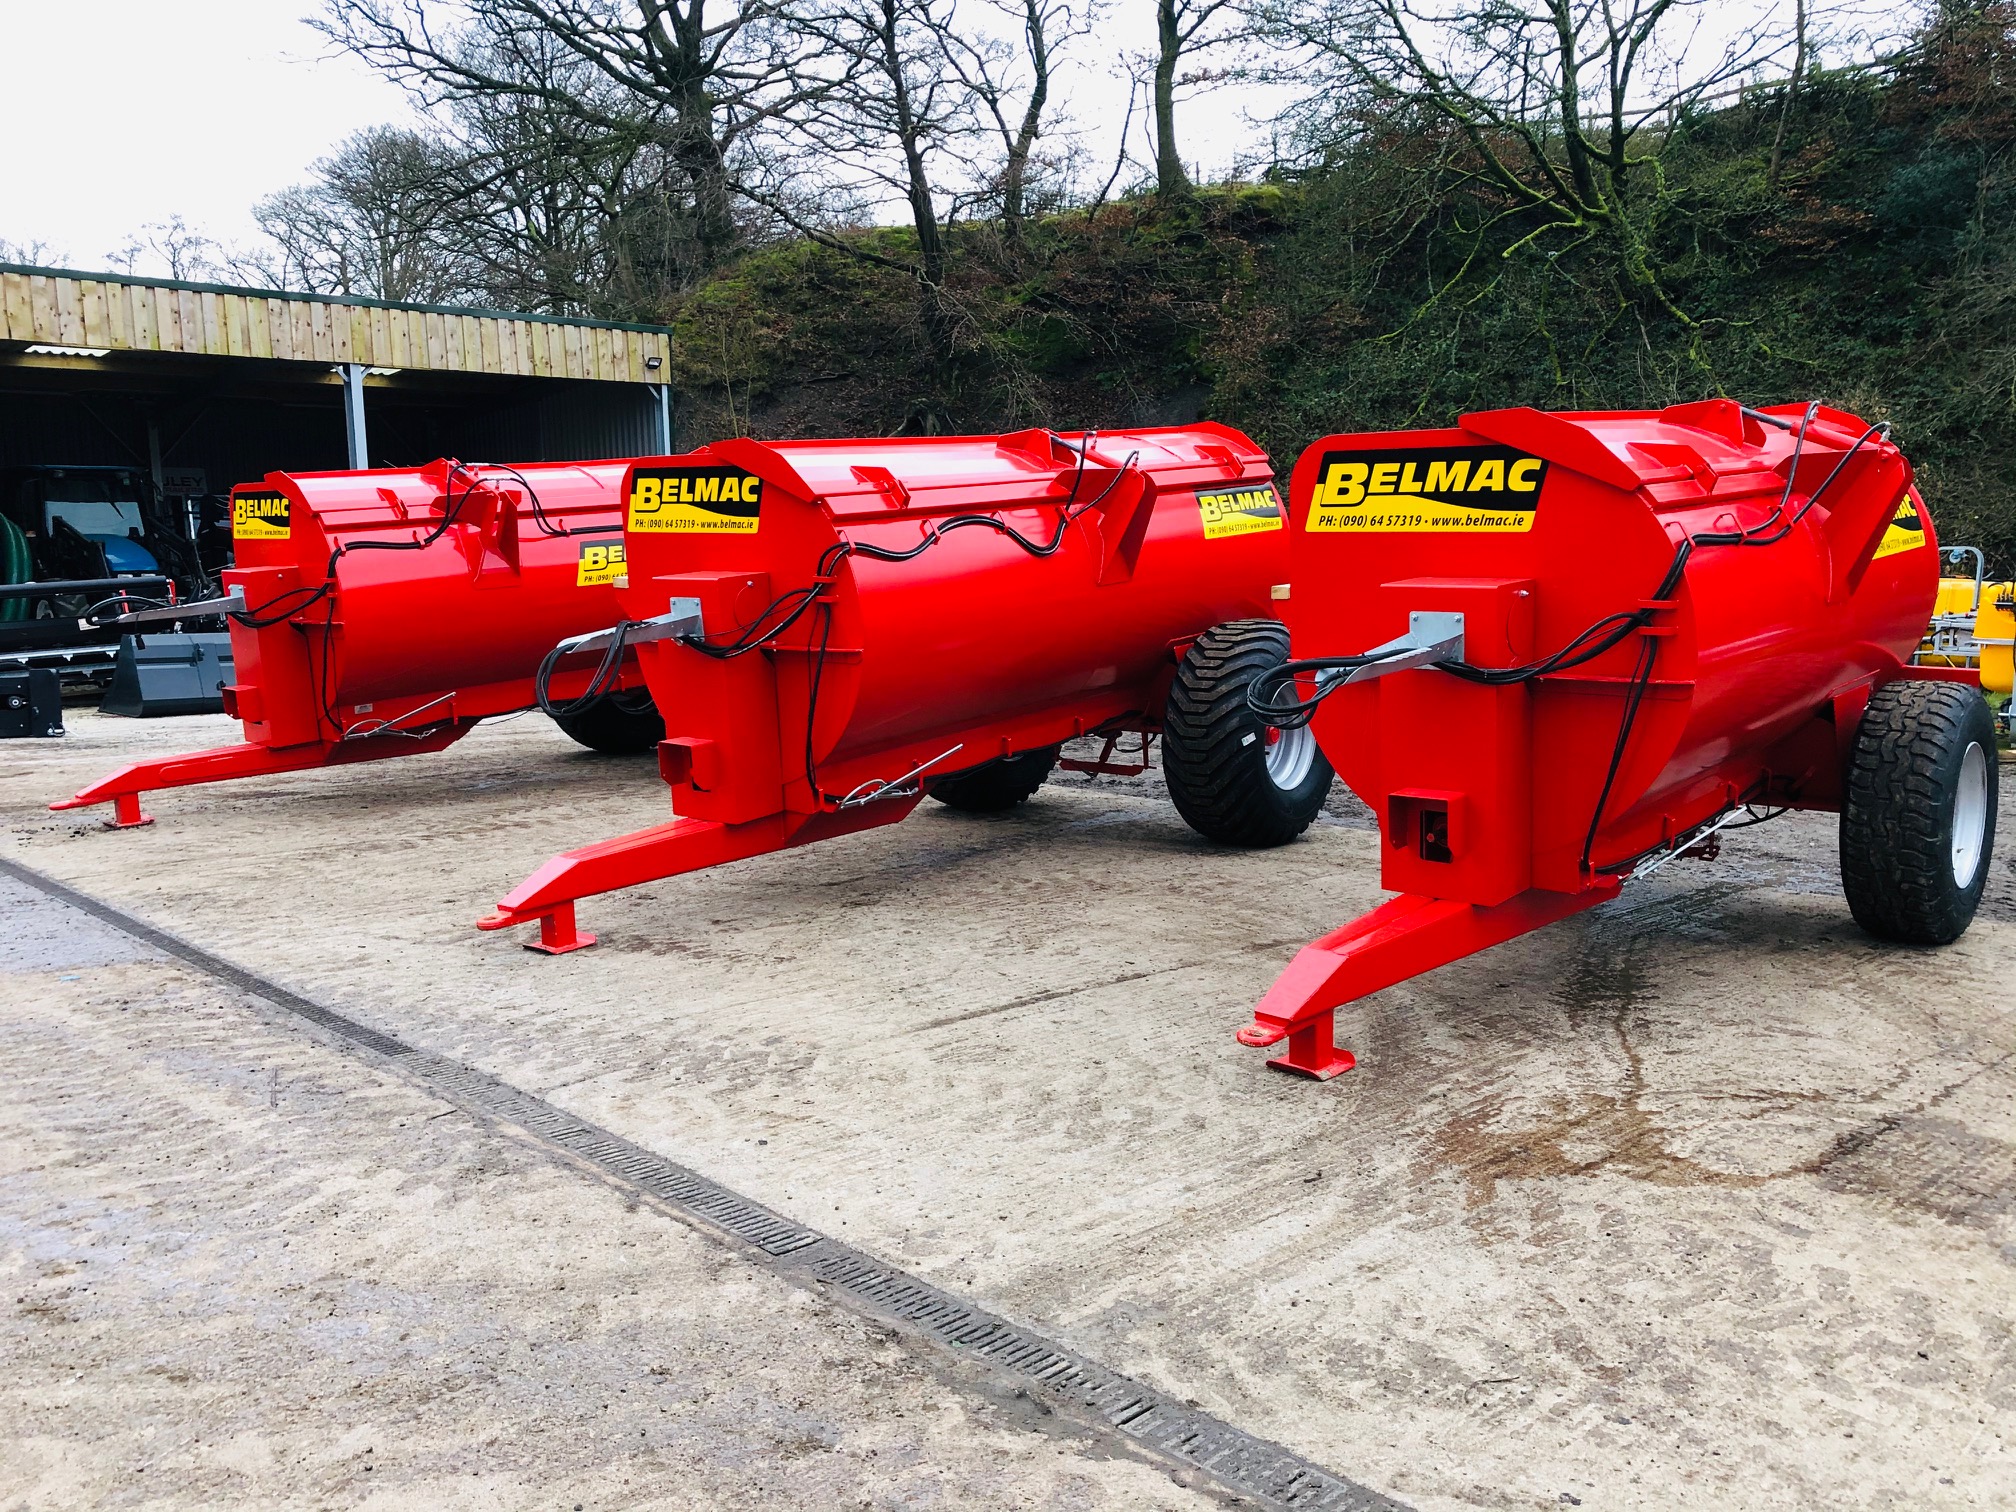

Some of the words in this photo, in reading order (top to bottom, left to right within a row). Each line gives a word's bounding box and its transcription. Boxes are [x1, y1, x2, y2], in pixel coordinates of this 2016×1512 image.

[635, 476, 760, 512] BELMAC
[1320, 458, 1542, 507] BELMAC
[235, 498, 289, 524] BELMAC
[1199, 490, 1277, 522] BELMAC
[635, 519, 646, 528] PH:
[647, 519, 664, 529] (090)
[665, 519, 673, 528] 64
[674, 519, 695, 528] 57319
[700, 519, 754, 529] www.belmac.ie
[1318, 515, 1337, 526] PH:
[1339, 514, 1368, 528] (090)
[1370, 515, 1383, 526] 64
[1386, 515, 1422, 526] 57319
[1431, 513, 1524, 527] www.belmac.ie
[584, 545, 627, 572] BE
